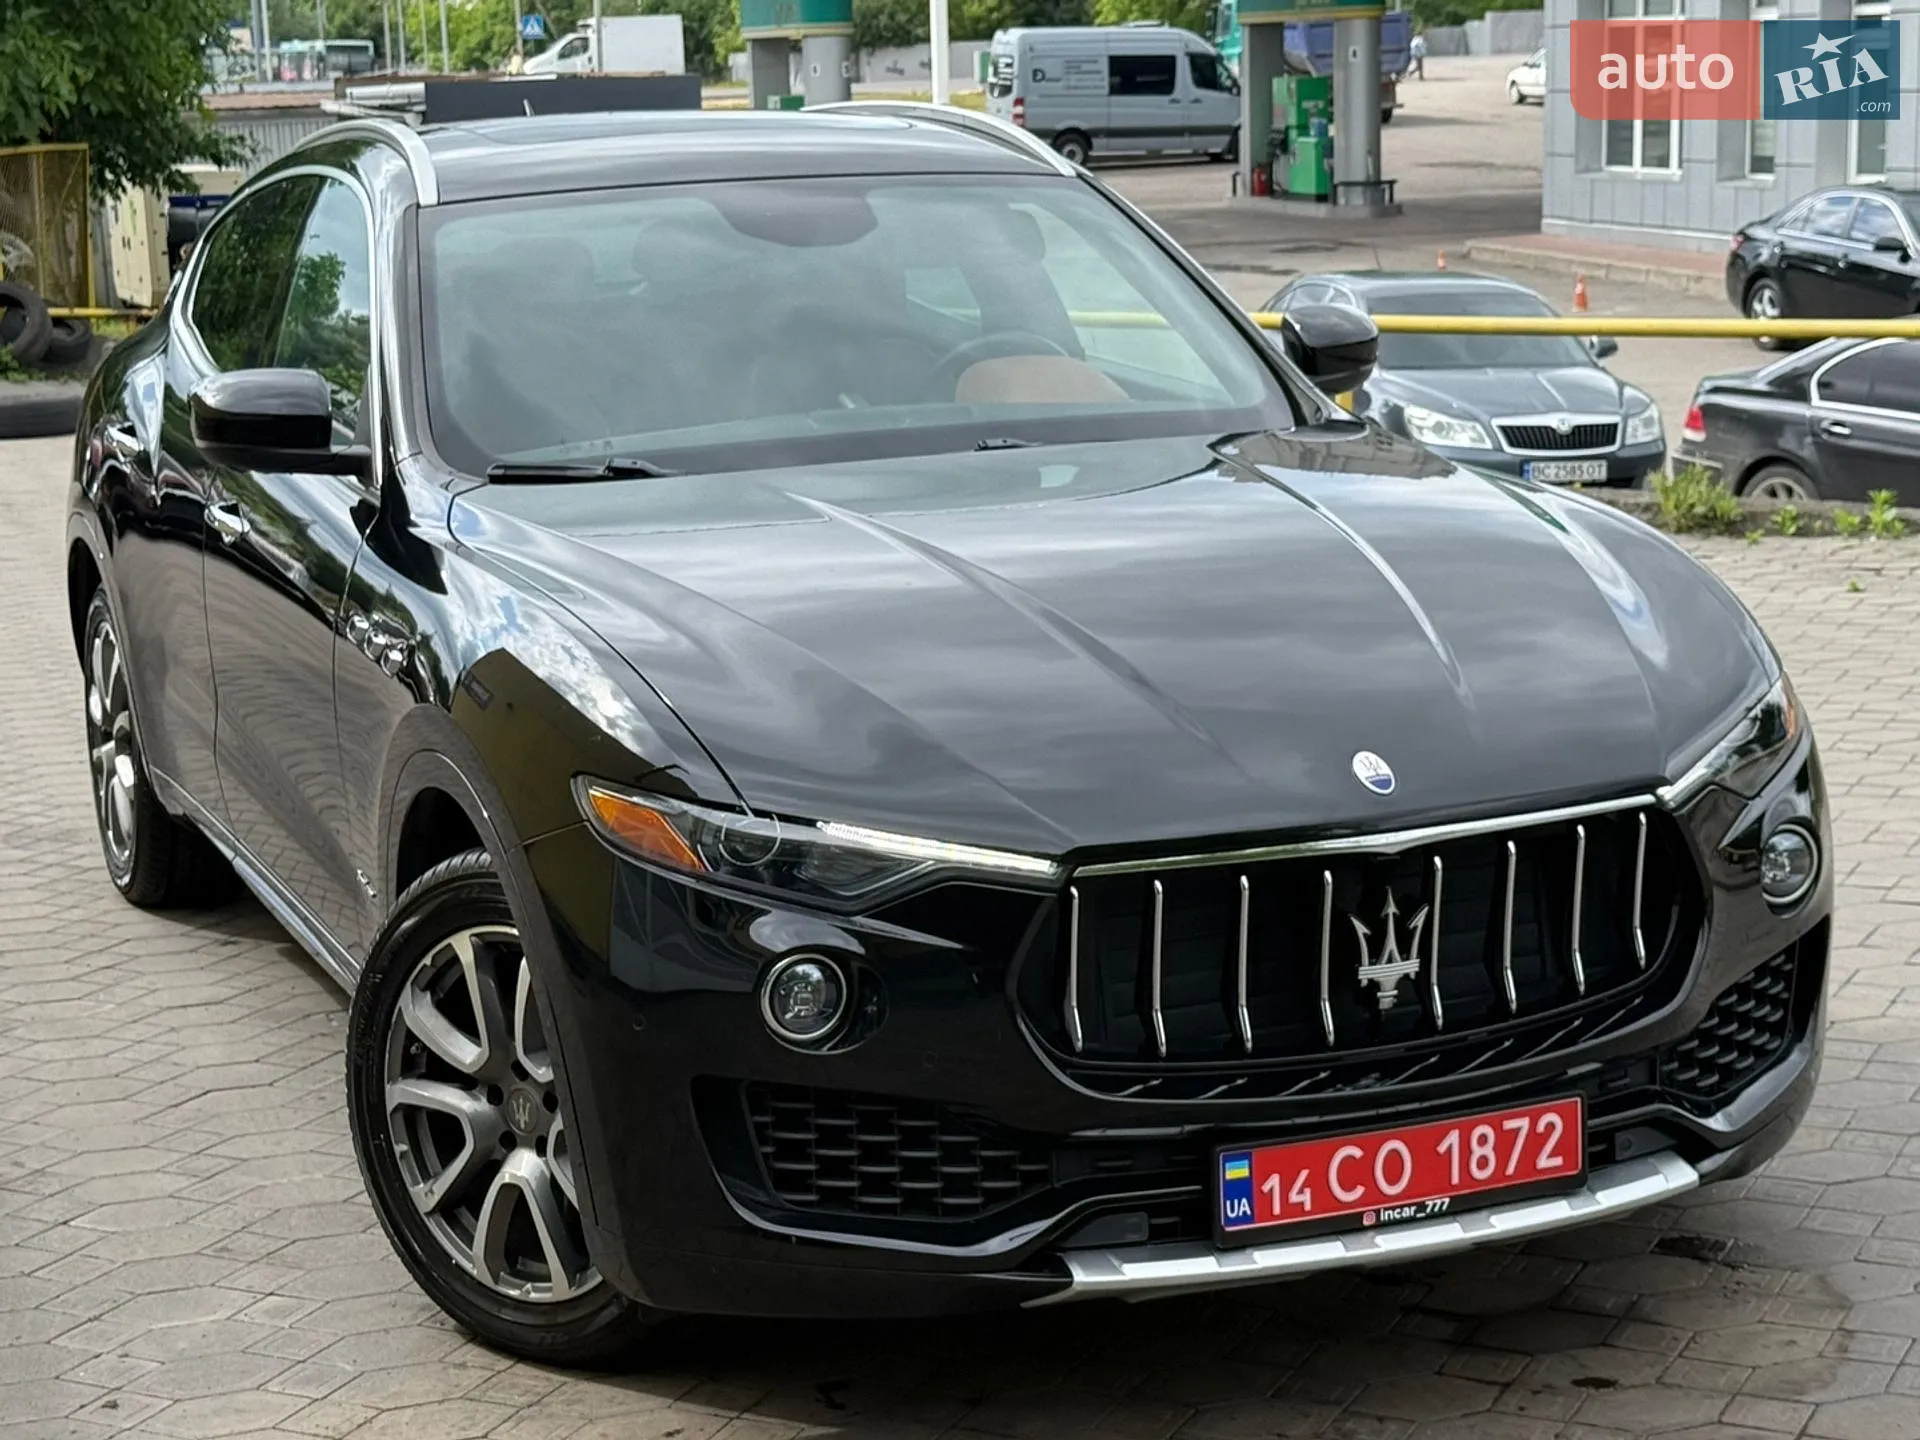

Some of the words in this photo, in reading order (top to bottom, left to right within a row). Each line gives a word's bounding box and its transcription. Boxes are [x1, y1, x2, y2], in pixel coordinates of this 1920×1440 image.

[1261, 1168, 1312, 1215] 14
[1328, 1139, 1412, 1203] CO
[1436, 1112, 1564, 1186] 1872
[1226, 1198, 1251, 1218] UA
